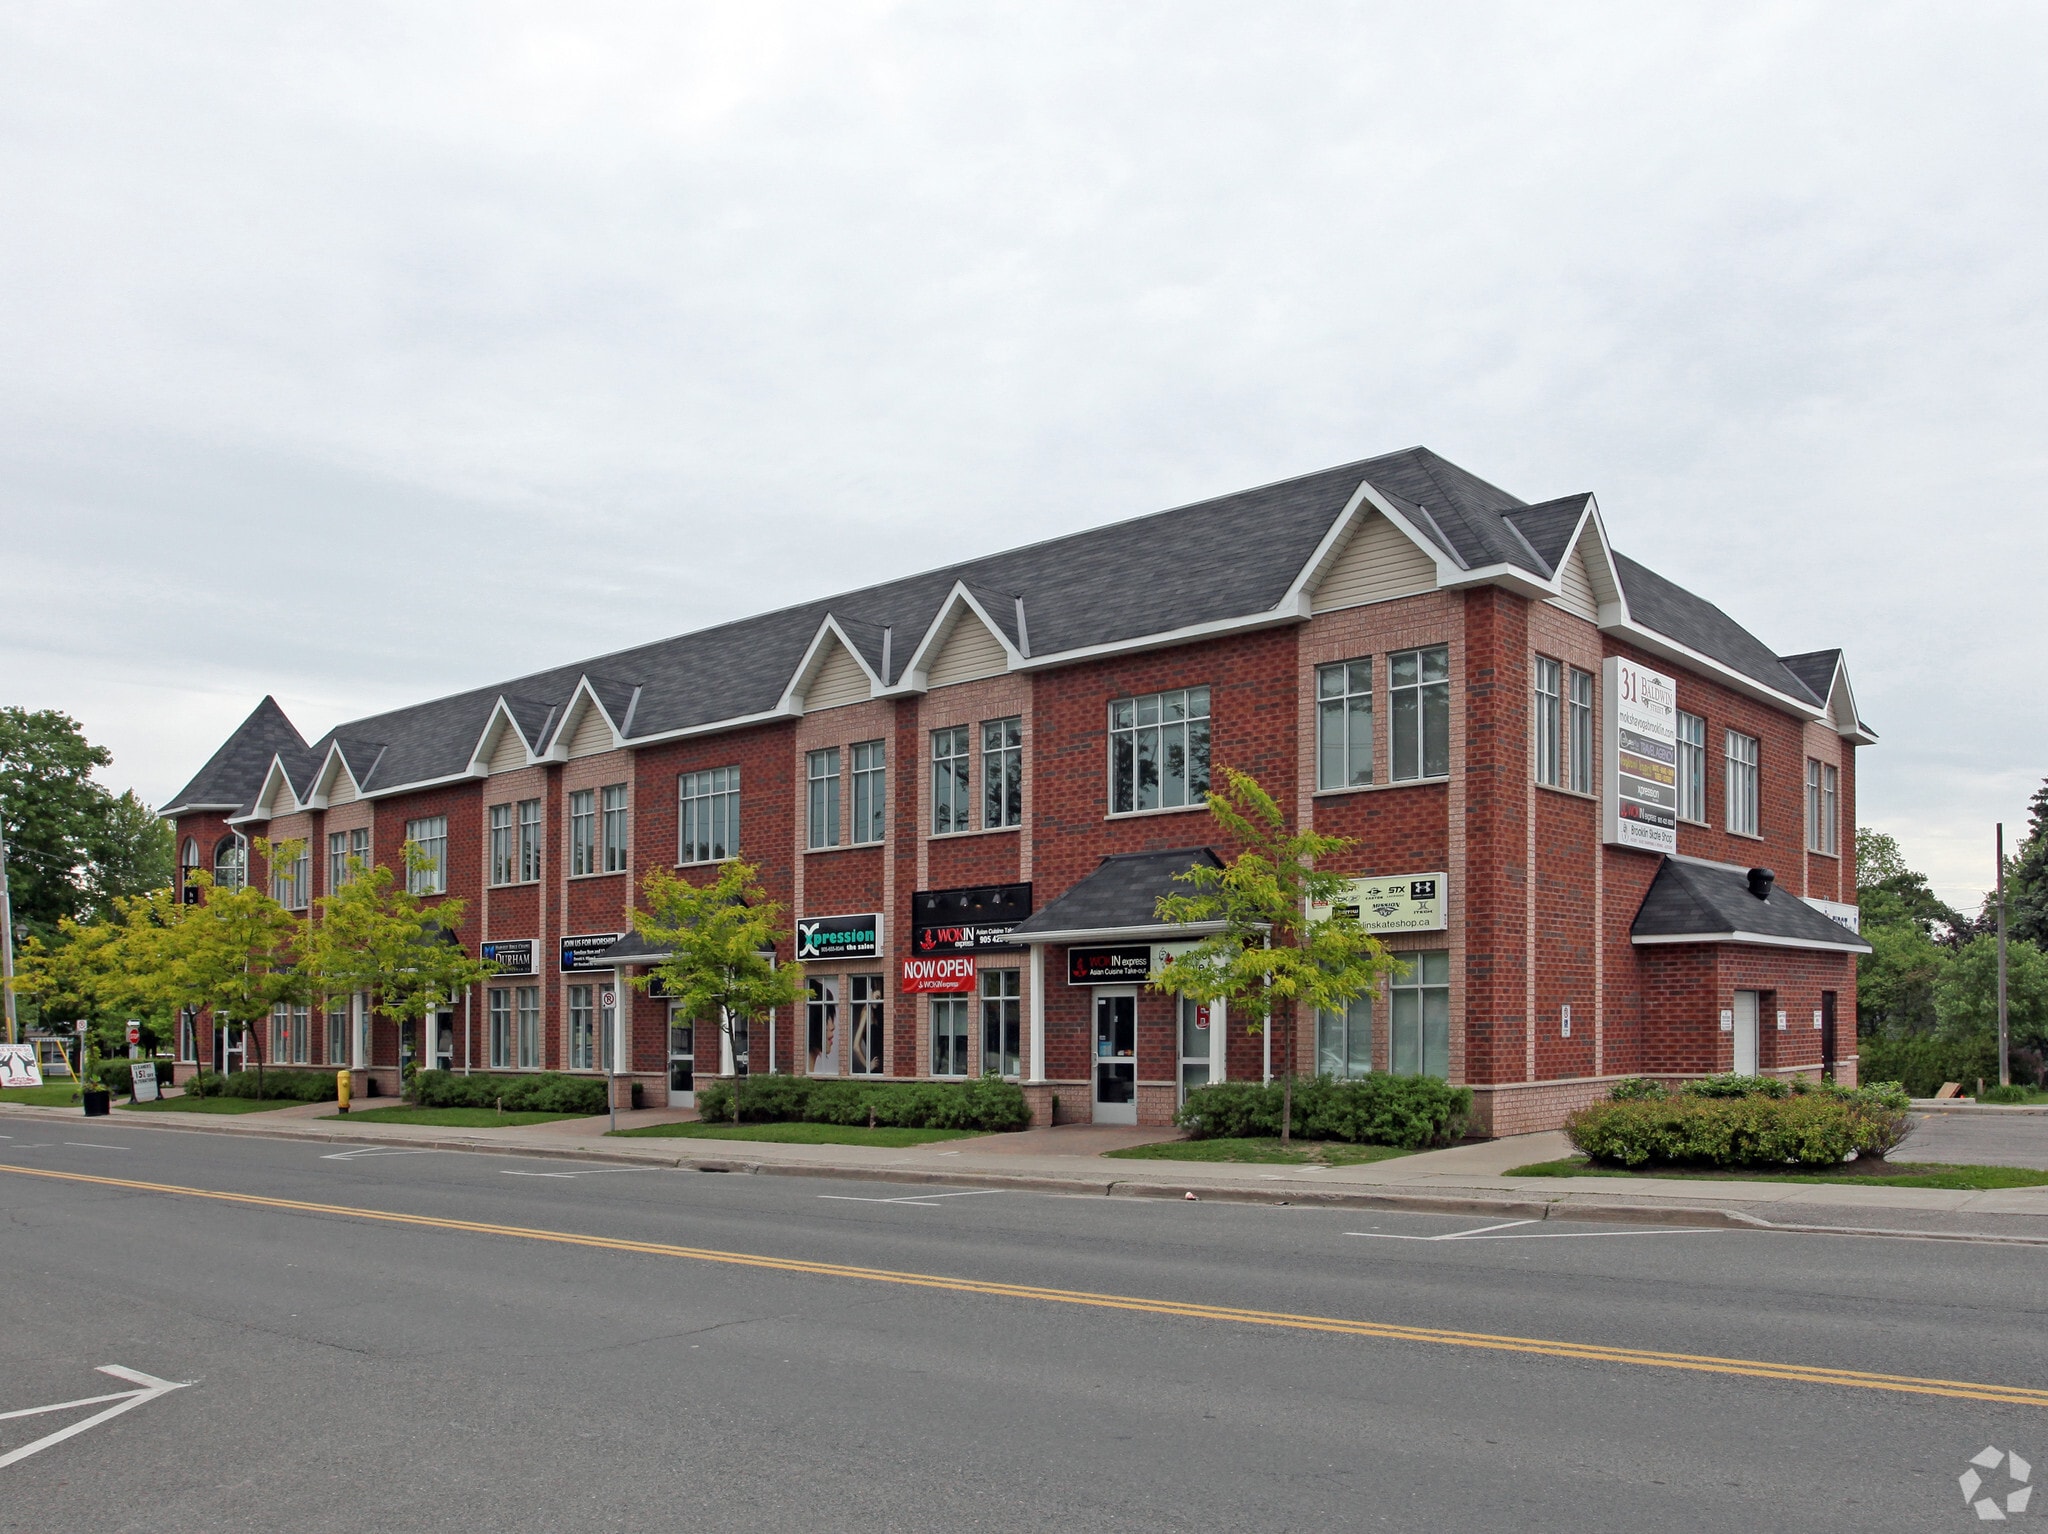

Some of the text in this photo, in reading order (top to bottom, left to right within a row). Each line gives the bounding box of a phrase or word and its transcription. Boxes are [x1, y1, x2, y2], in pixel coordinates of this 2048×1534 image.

[1621, 667, 1673, 706] 31 BALDWIN
[1649, 703, 1664, 715] STREET
[1637, 785, 1660, 800] xpression
[1631, 824, 1649, 838] Brooklin
[1649, 828, 1661, 841] Skate
[1661, 831, 1673, 844] Shop
[1388, 886, 1406, 894] STX
[563, 940, 575, 948] JOIN
[574, 939, 582, 947] US
[581, 938, 592, 946] FOR
[979, 934, 991, 944] 905
[495, 953, 530, 966] DURHAM
[1121, 957, 1147, 967] express
[904, 958, 974, 979] NOW OPEN
[1089, 966, 1147, 976] Asian Cuisine Take-out
